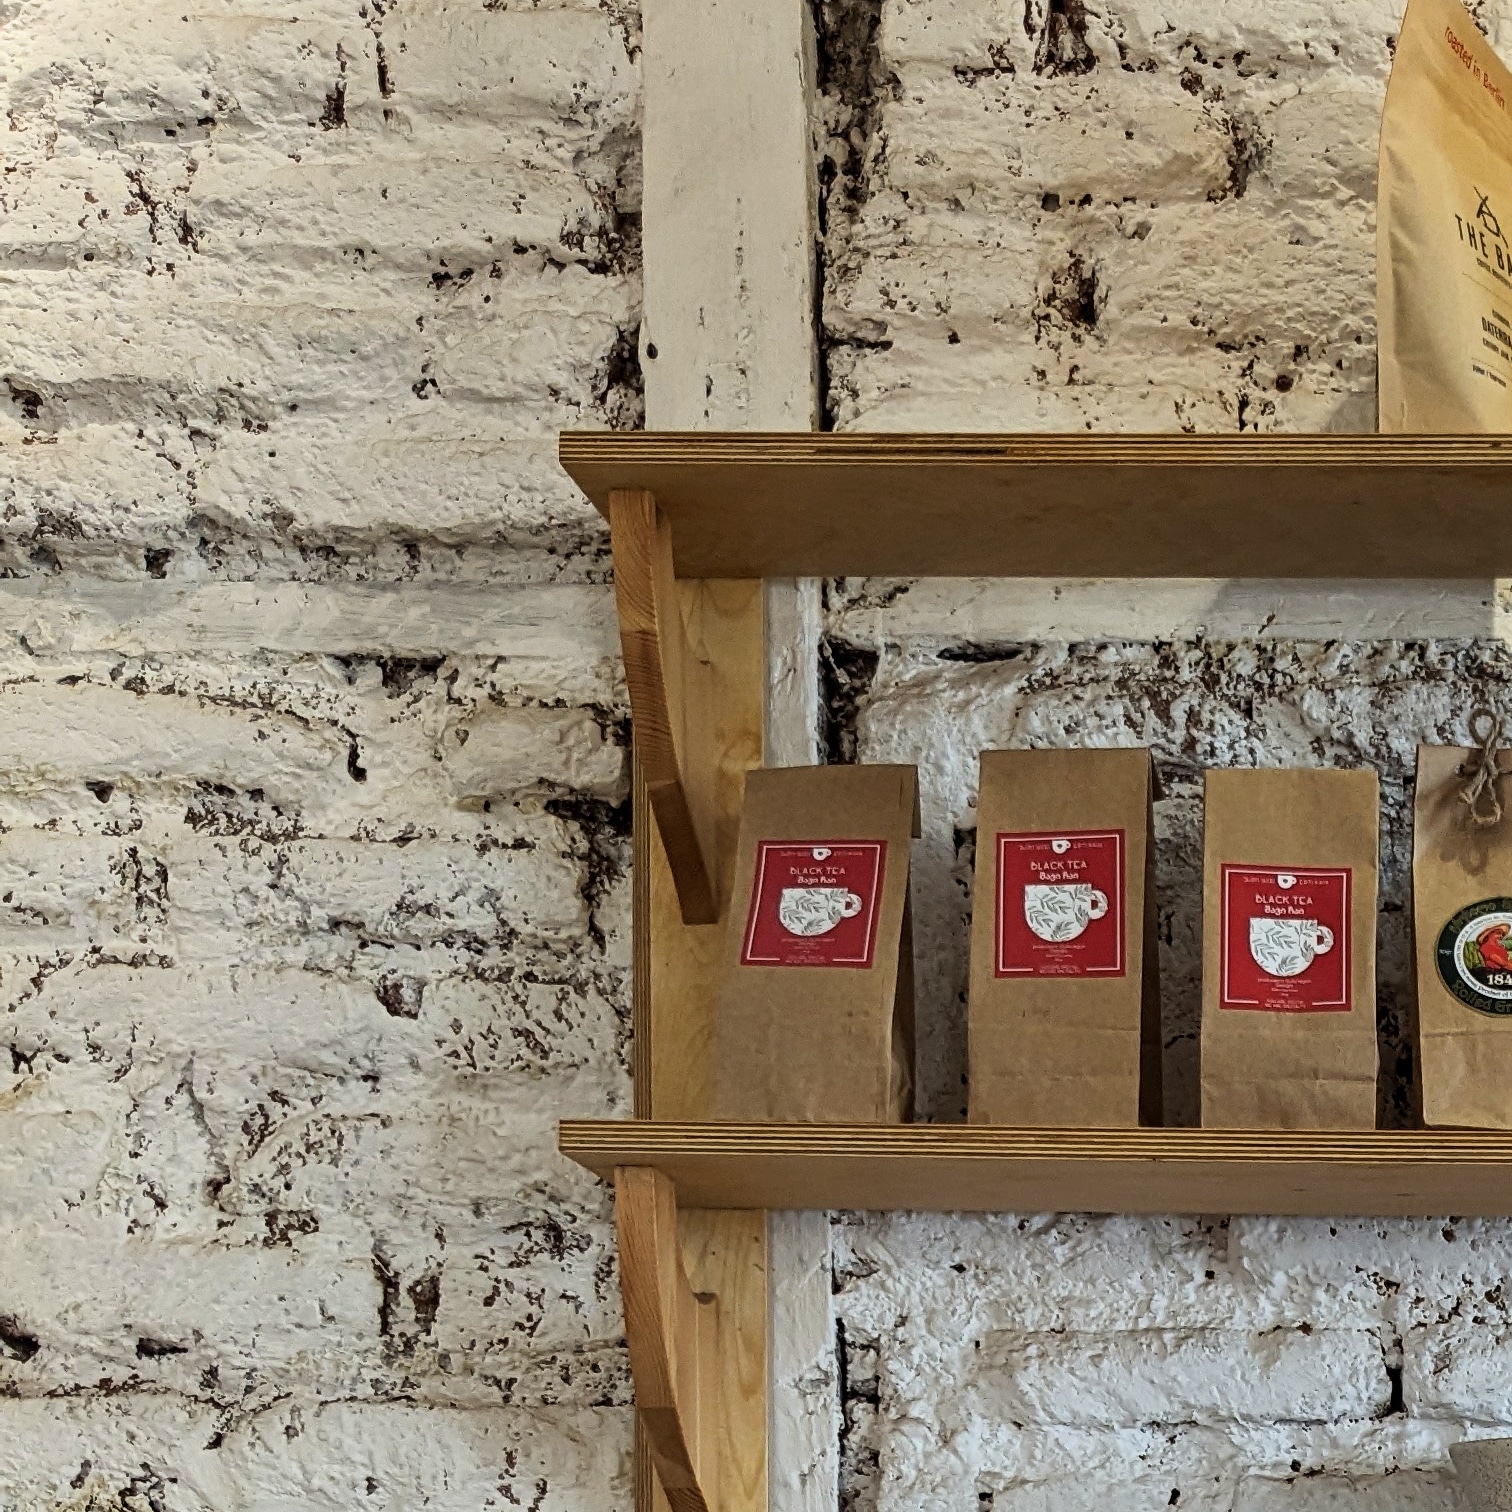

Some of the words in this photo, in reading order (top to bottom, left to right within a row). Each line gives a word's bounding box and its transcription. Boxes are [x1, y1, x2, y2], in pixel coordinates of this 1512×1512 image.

[1444, 26, 1474, 70] roasted
[1455, 213, 1488, 259] THE
[790, 866, 822, 875] BLACK
[826, 866, 846, 875] TEA
[1030, 860, 1066, 871] BLACK
[1067, 860, 1088, 870] TEA
[1255, 894, 1290, 904] BLACK
[1292, 896, 1313, 905] TEA
